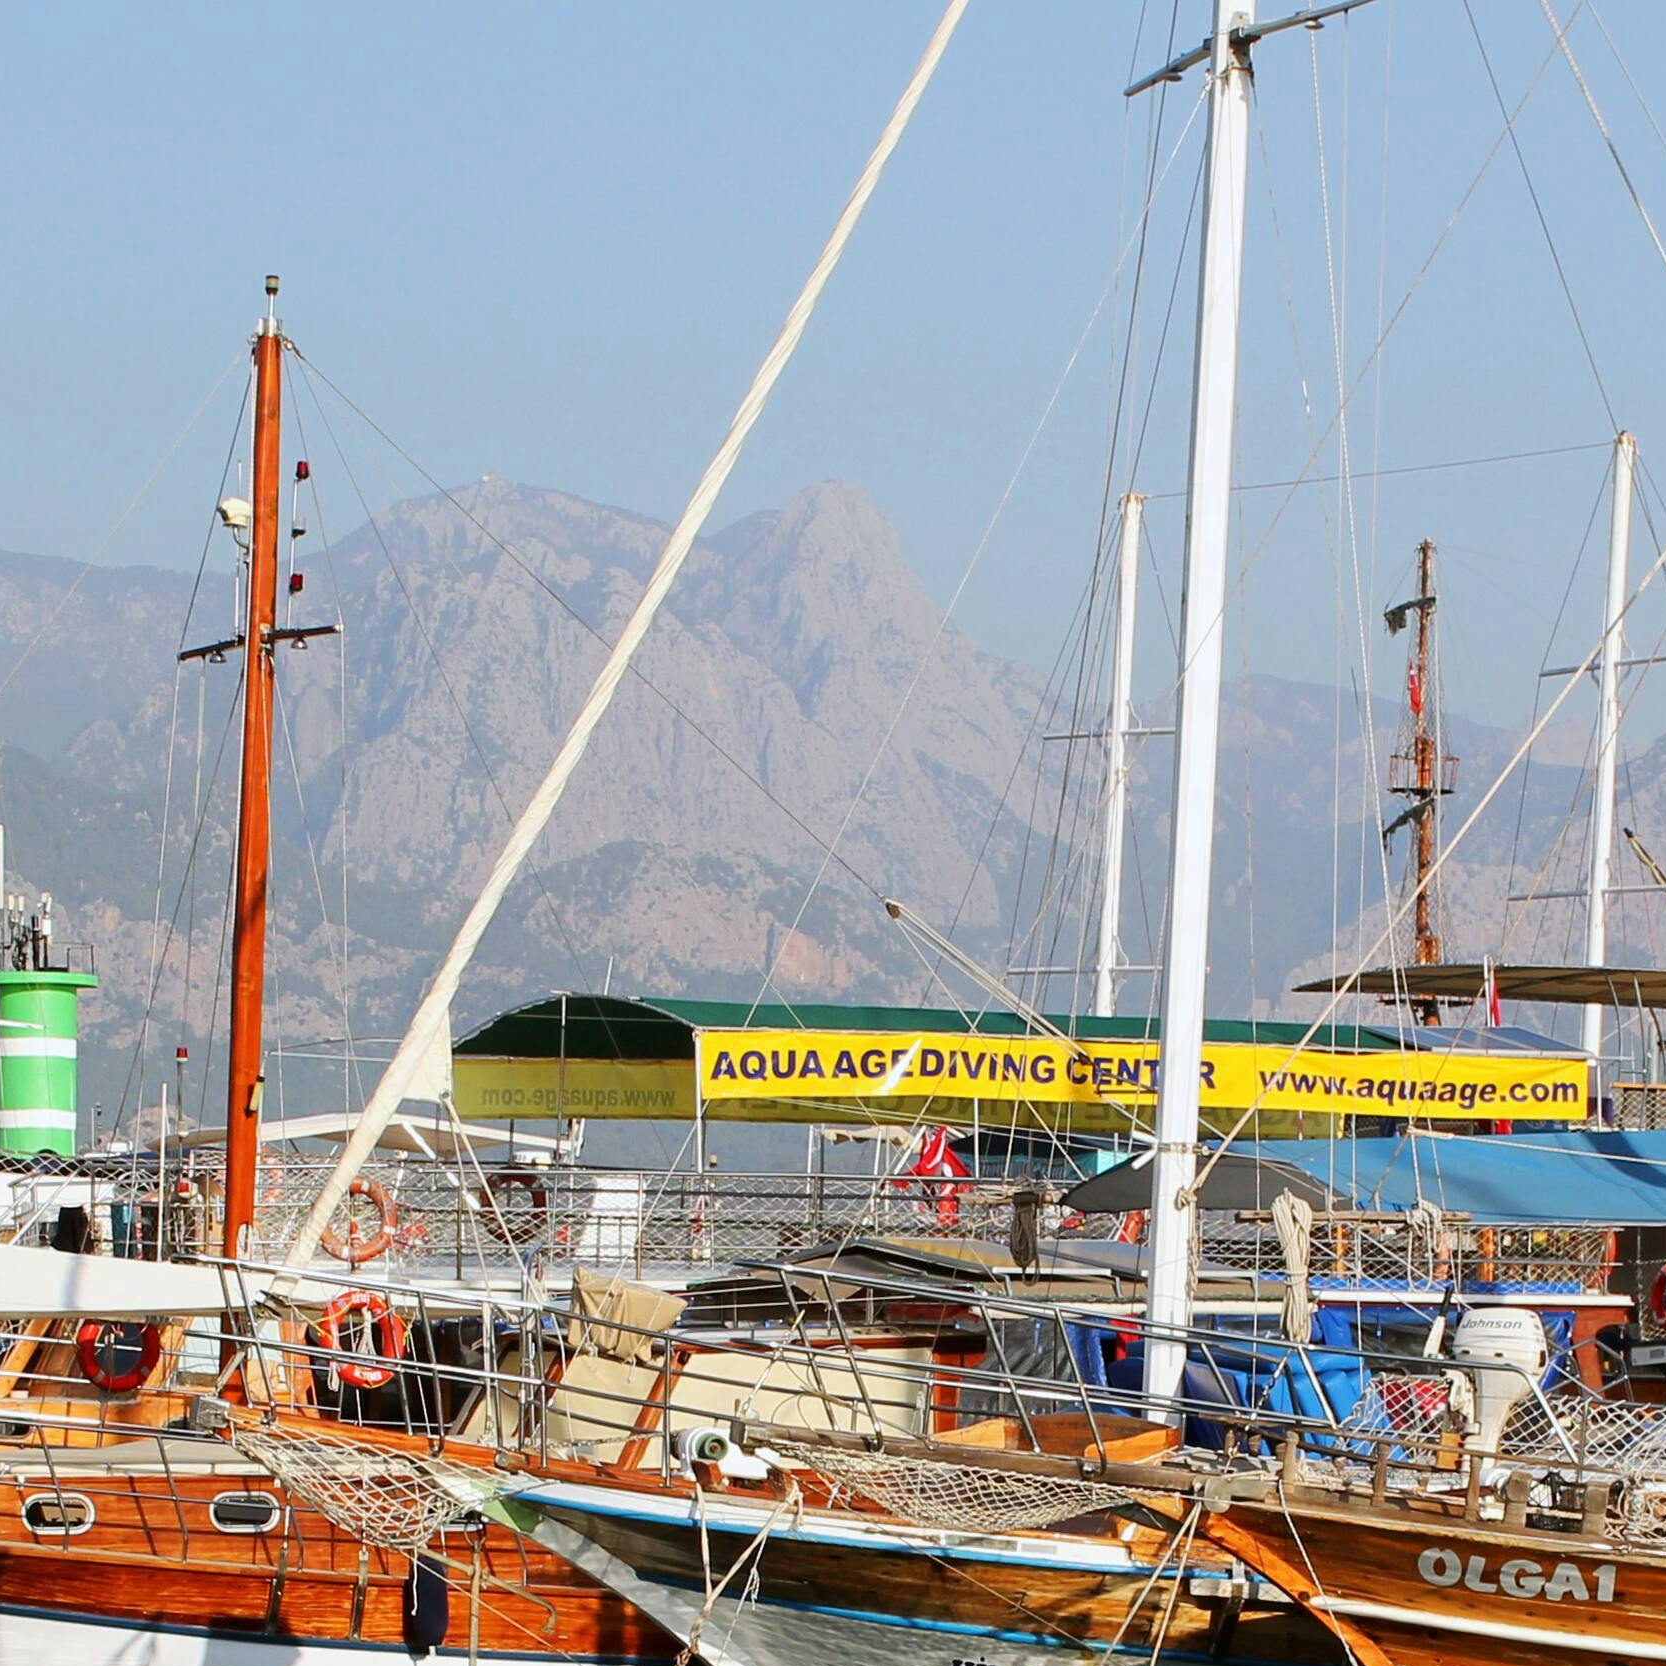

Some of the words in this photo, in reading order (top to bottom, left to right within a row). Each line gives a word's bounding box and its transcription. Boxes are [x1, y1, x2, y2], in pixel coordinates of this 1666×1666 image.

[710, 1049, 826, 1081] AQUA
[832, 1049, 915, 1079] AGE
[919, 1048, 1056, 1083] DIVING
[1065, 1055, 1216, 1089] CENTR
[1258, 1069, 1579, 1109] www.aquaage.com
[1461, 1318, 1524, 1329] Johnson
